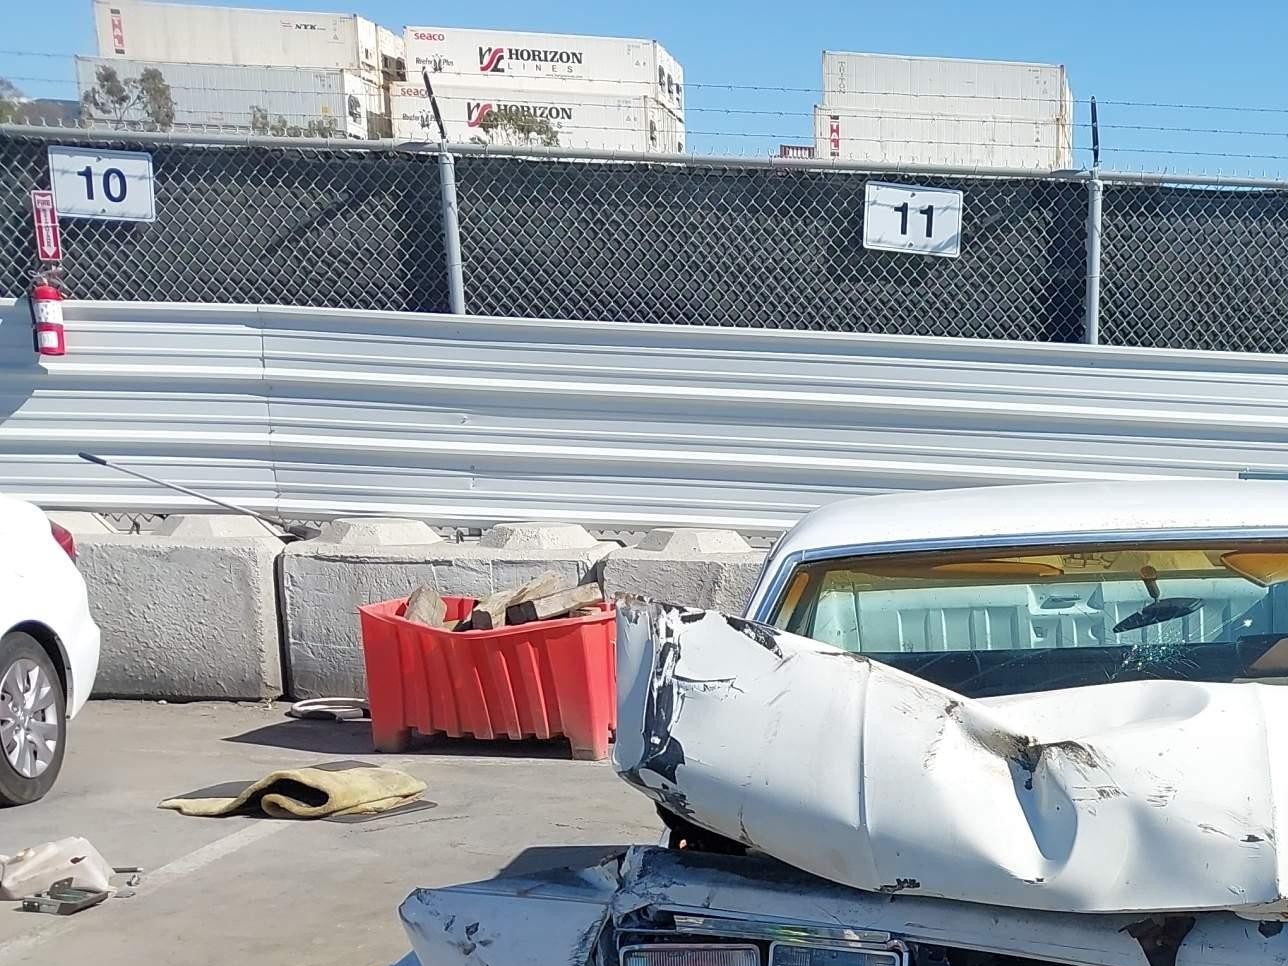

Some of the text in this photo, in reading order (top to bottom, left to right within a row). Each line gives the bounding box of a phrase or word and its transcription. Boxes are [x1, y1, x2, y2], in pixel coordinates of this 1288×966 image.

[414, 32, 445, 41] seaco
[508, 48, 583, 64] HORIZON
[508, 63, 574, 73] LINES
[77, 166, 127, 203] 10
[894, 202, 934, 238] 11
